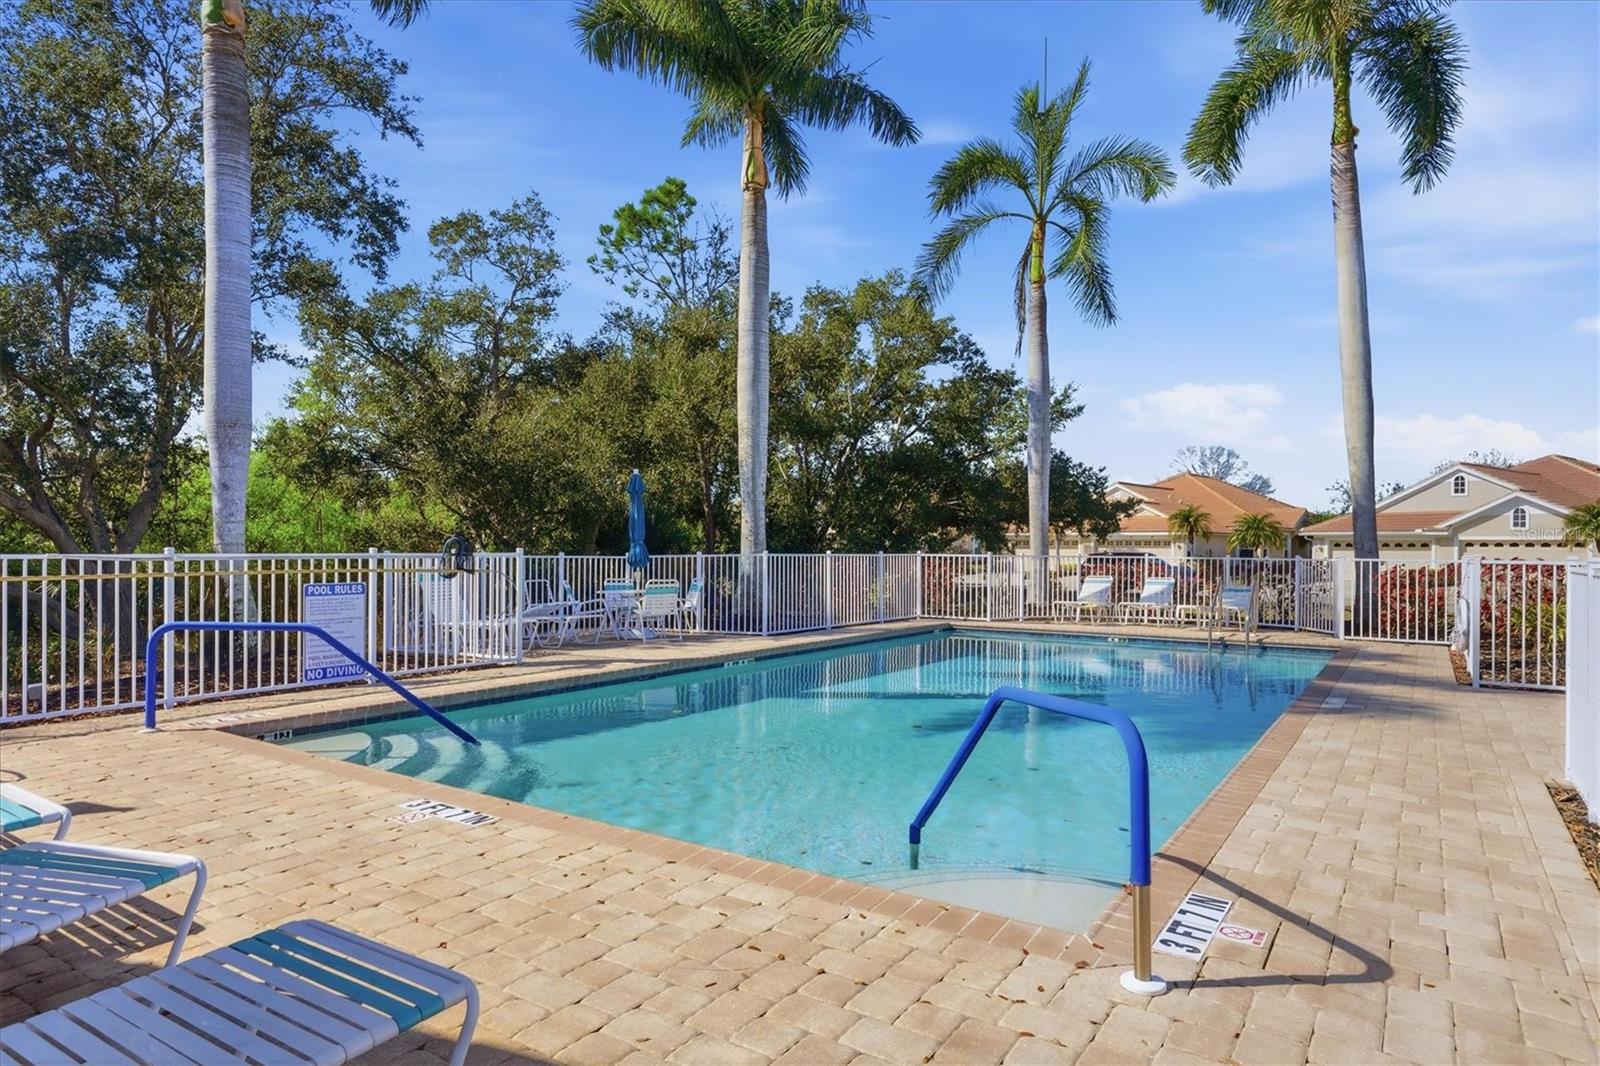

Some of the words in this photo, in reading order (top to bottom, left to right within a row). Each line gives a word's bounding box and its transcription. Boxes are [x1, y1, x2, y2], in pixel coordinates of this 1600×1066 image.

[307, 585, 333, 595] POOL
[334, 584, 363, 594] RULES
[307, 669, 324, 680] NO
[326, 664, 364, 678] DIVING
[419, 803, 456, 815] FT
[460, 814, 496, 825] IN
[1185, 893, 1230, 913] IN
[1177, 908, 1220, 923] 7
[1165, 919, 1213, 942] FT
[1159, 938, 1202, 954] 3
